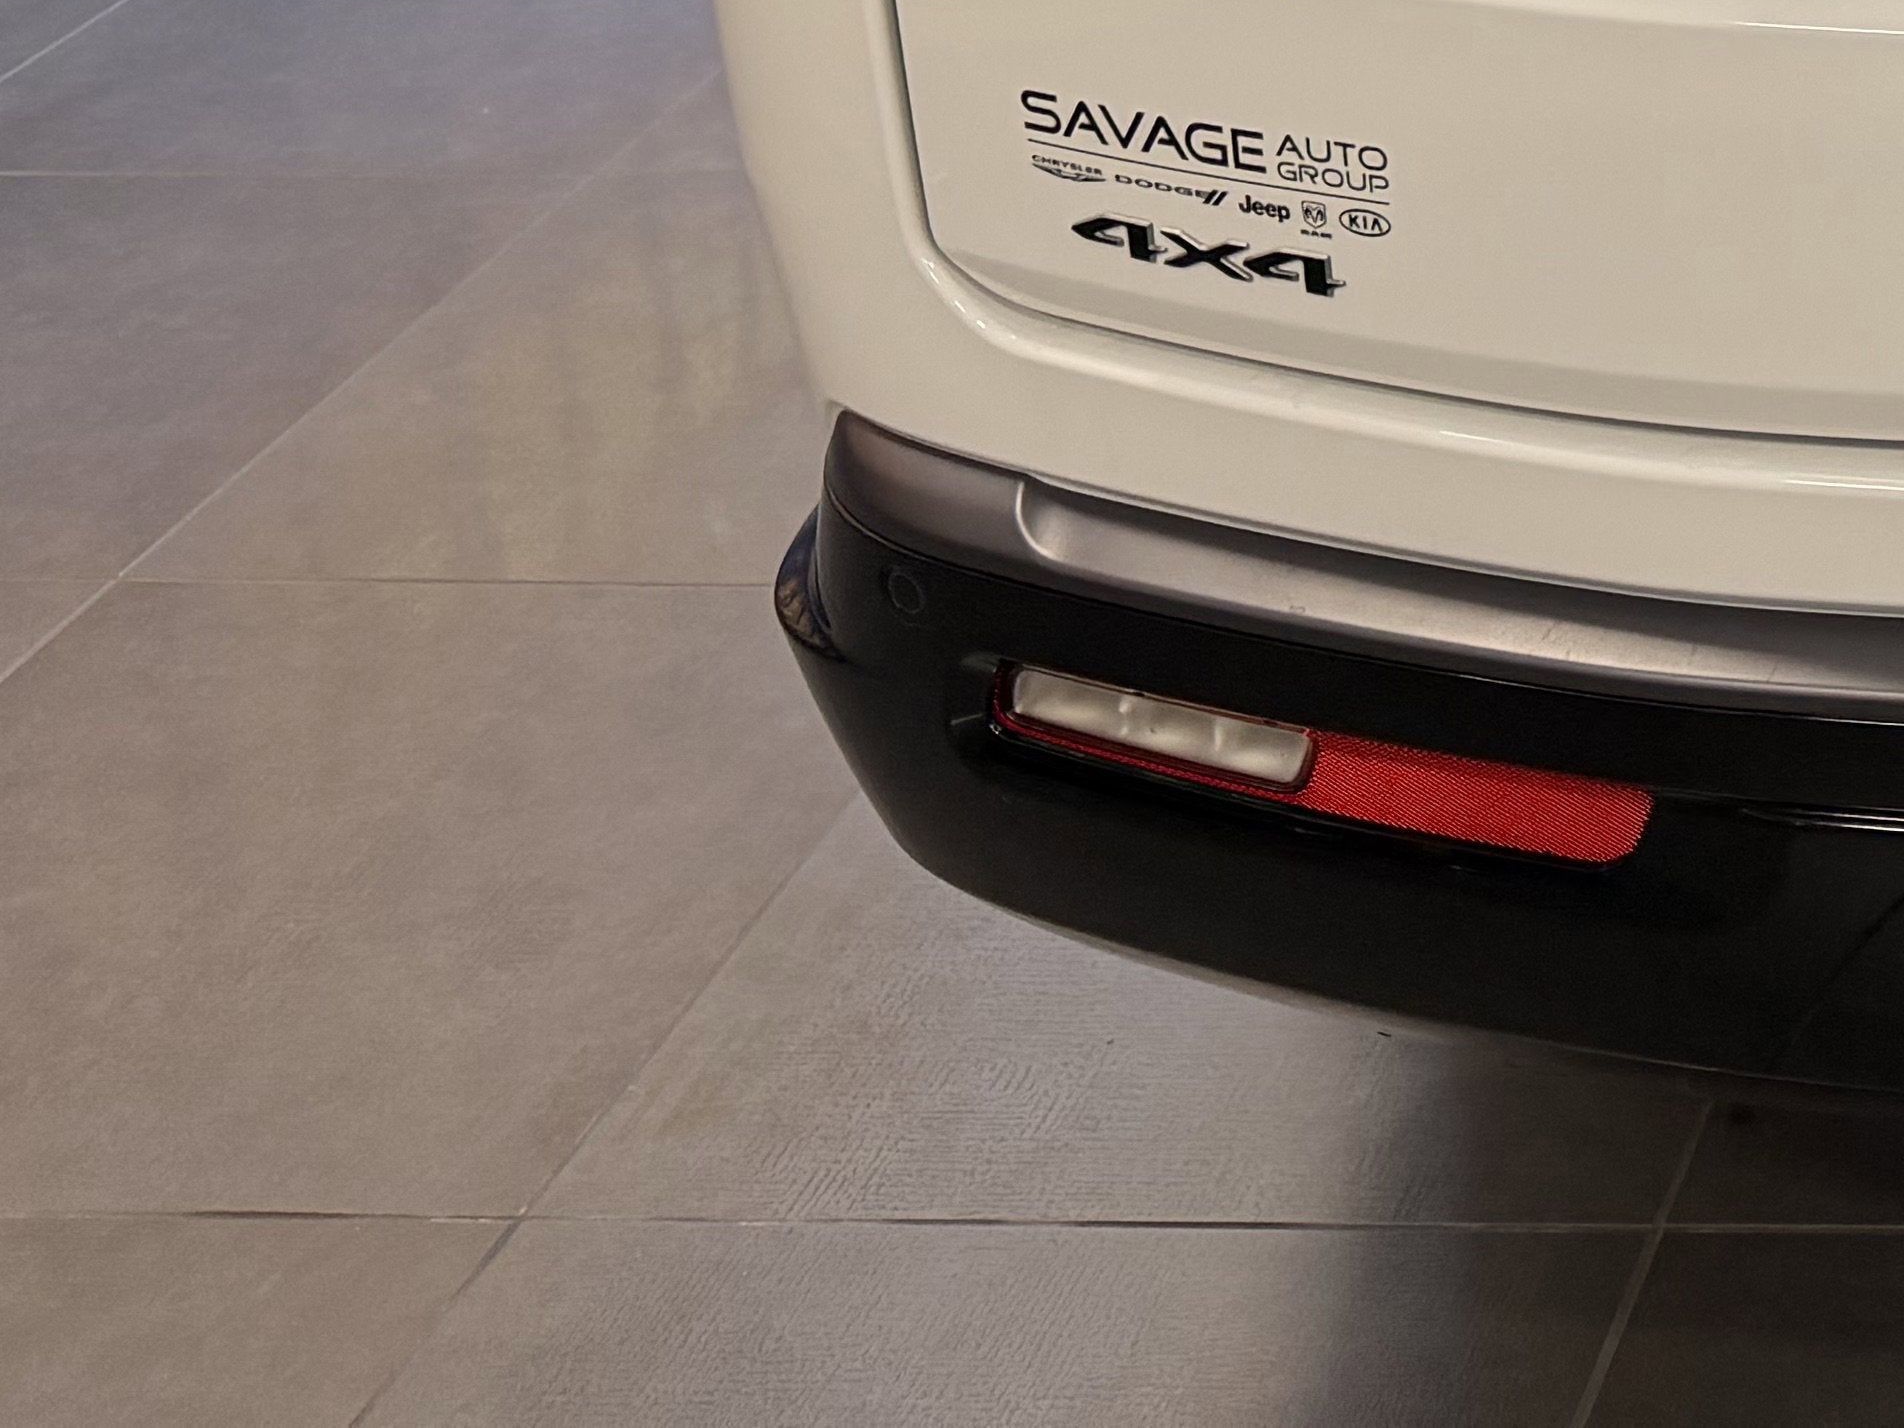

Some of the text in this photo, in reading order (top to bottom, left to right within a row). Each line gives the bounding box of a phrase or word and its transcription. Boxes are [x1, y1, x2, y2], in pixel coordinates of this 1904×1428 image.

[1020, 89, 1389, 174] SAVAGE AUTO
[1031, 154, 1103, 175] CHRYSLER
[1277, 160, 1390, 194] GROUP
[1238, 194, 1290, 223] Jeep
[1348, 212, 1383, 233] KIA
